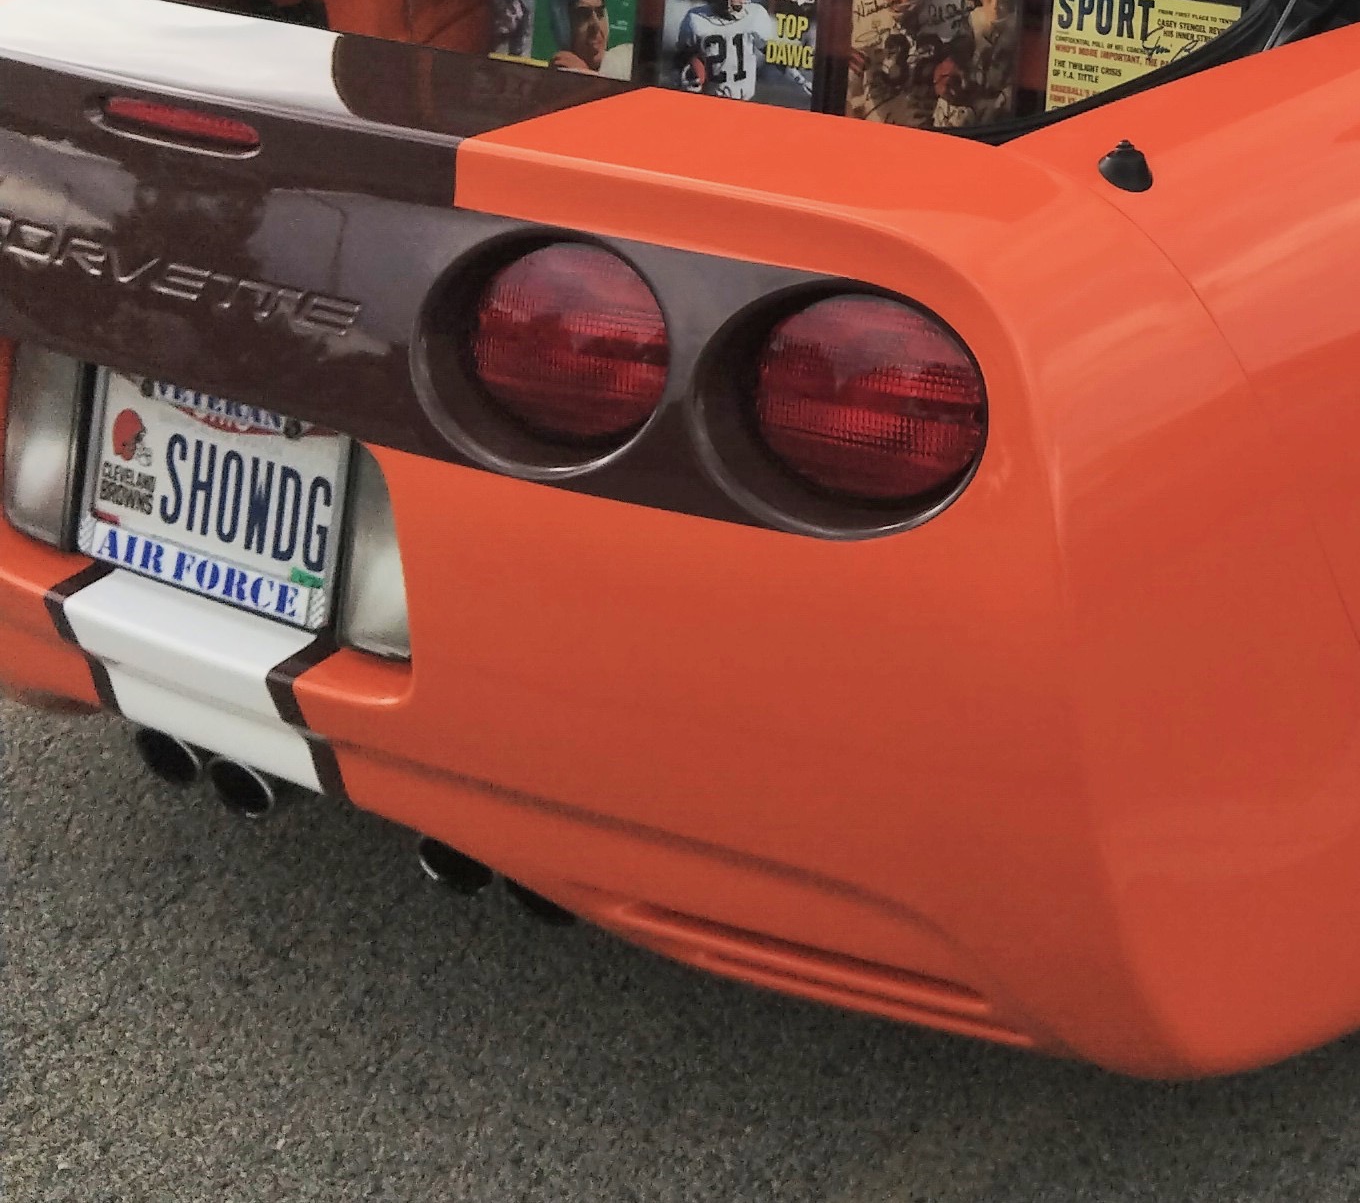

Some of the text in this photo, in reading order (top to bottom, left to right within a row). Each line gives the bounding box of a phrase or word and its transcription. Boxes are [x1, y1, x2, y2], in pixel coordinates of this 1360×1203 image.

[775, 12, 809, 41] TOP
[1157, 18, 1177, 29] CASEY
[1179, 22, 1206, 34] STENGEL
[1176, 31, 1195, 40] INNER
[765, 41, 816, 70] DAWG
[1055, 35, 1090, 47] CONFIDENTIAL
[702, 33, 748, 84] 21
[1054, 58, 1122, 77] THE TWILIGHT CRISIS
[1052, 68, 1061, 77] OF
[1077, 72, 1099, 84] TITTLE
[102, 461, 157, 493] CLEVELAND
[98, 478, 154, 516] BROWNS
[158, 432, 333, 574] SHOWDG
[96, 528, 300, 618] AIR FORCE
